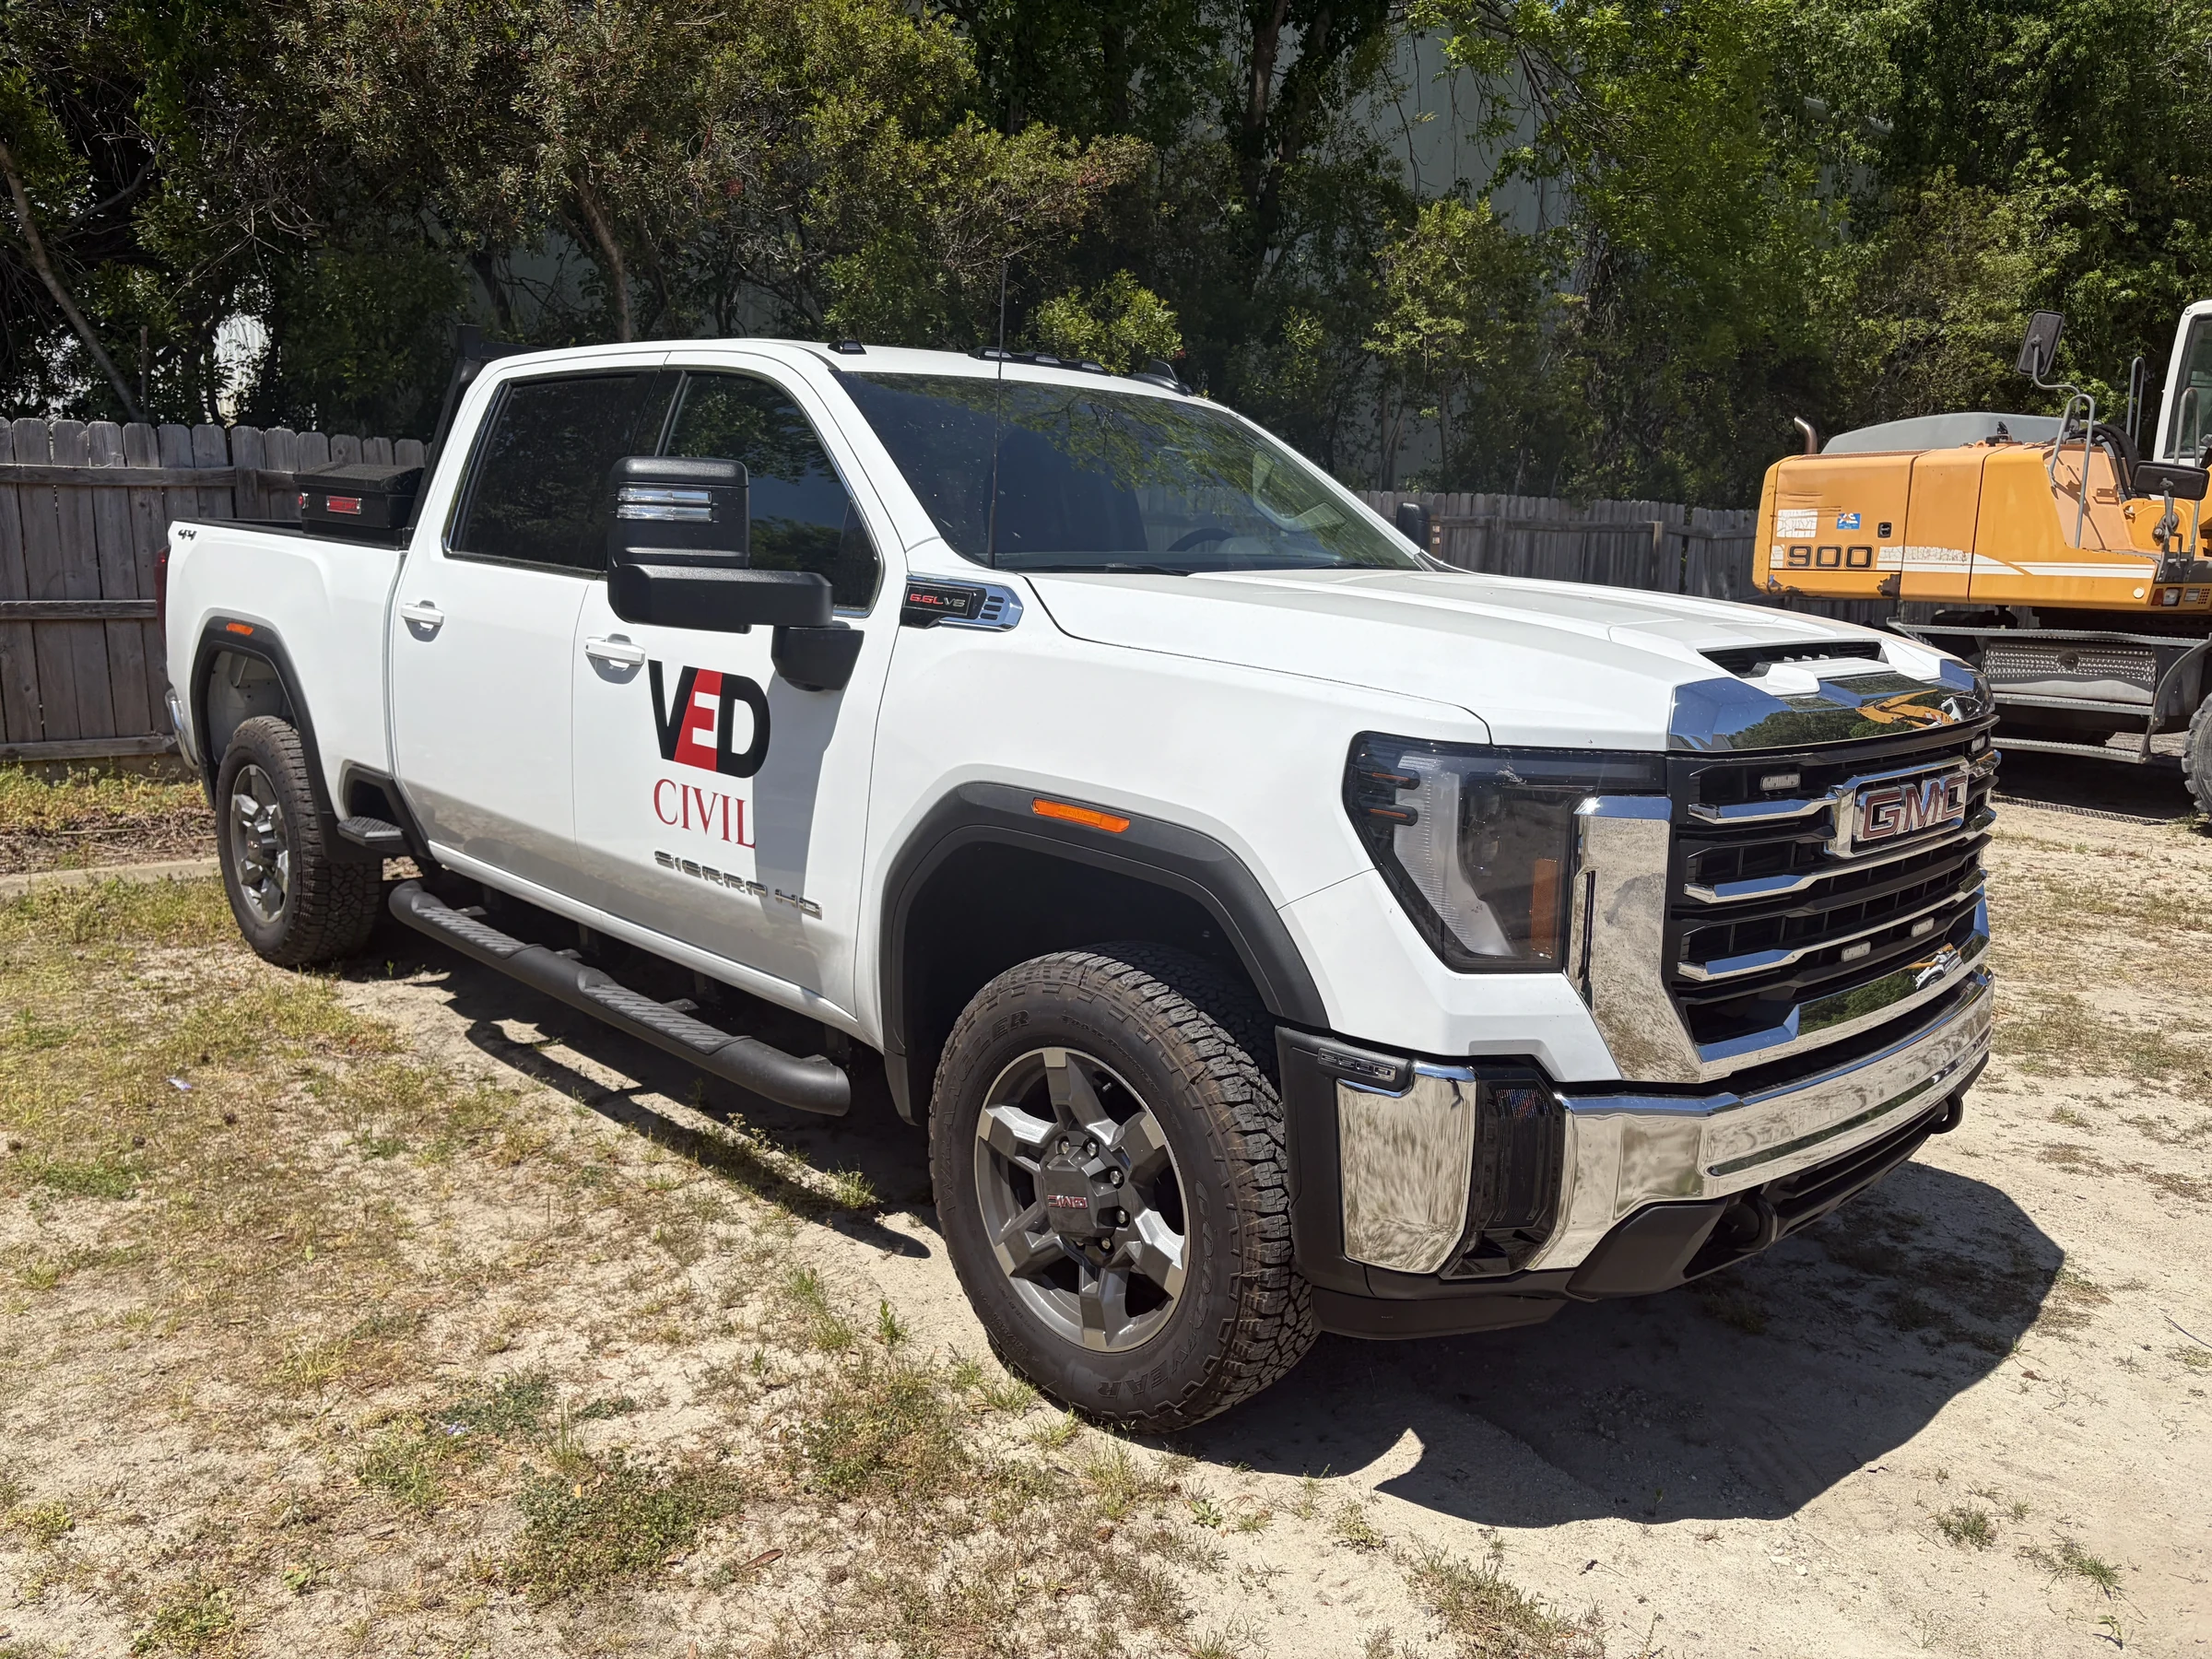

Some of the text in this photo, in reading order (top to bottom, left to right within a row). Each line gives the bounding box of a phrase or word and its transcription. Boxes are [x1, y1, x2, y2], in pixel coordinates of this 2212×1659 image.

[1787, 545, 1873, 569] 900
[647, 659, 771, 779] VED
[653, 778, 757, 849] CIVIL
[1856, 772, 1968, 841] GMC
[654, 850, 823, 921] SIERRA HD
[1048, 1194, 1088, 1209] GMC
